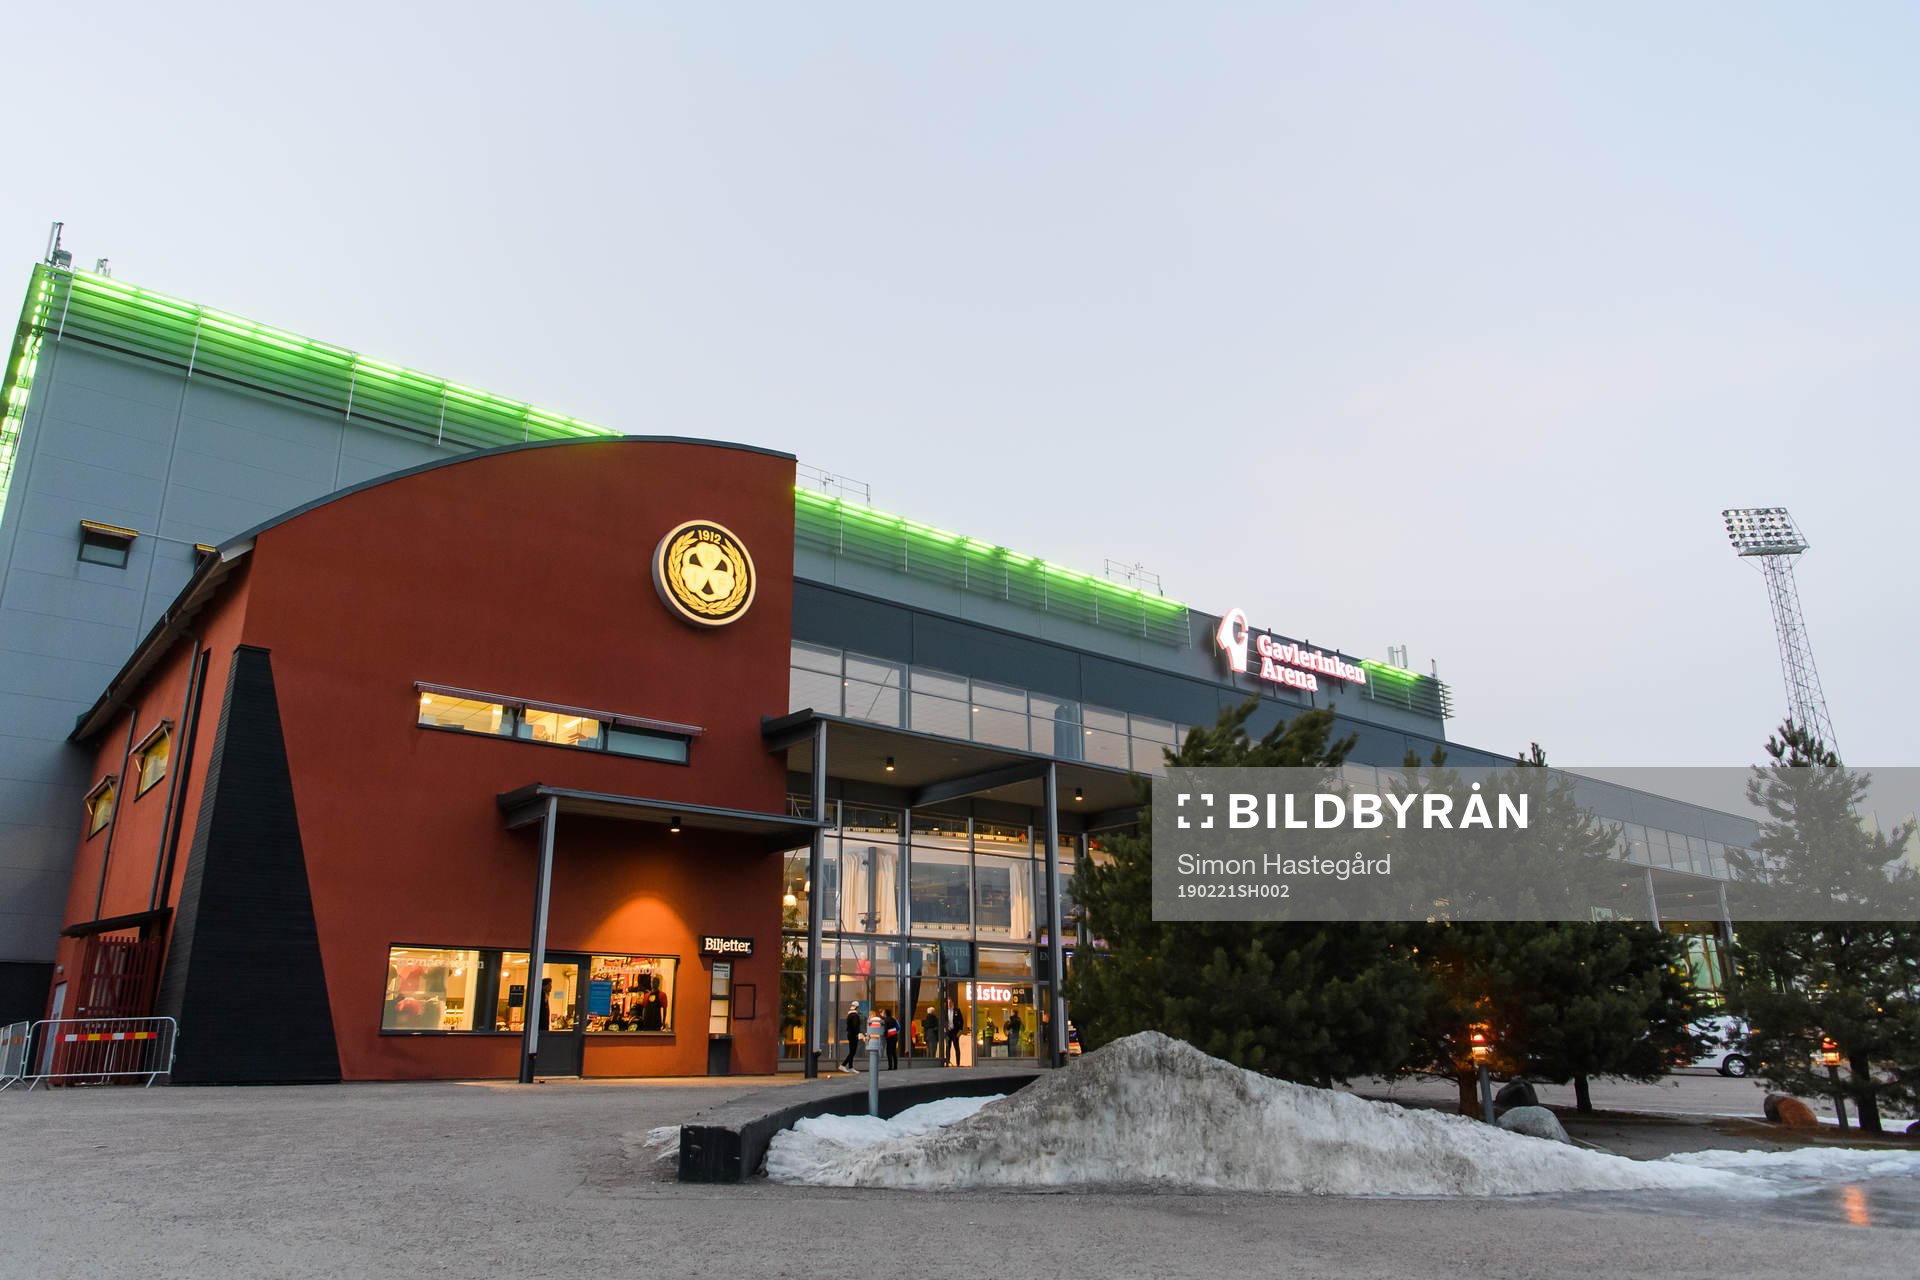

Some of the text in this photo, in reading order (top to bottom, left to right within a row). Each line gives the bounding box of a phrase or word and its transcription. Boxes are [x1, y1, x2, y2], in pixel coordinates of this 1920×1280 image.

[697, 529, 722, 545] 1912
[1256, 634, 1367, 685] Gavlerinken
[1259, 656, 1318, 693] Arena
[704, 937, 751, 953] Biljetter
